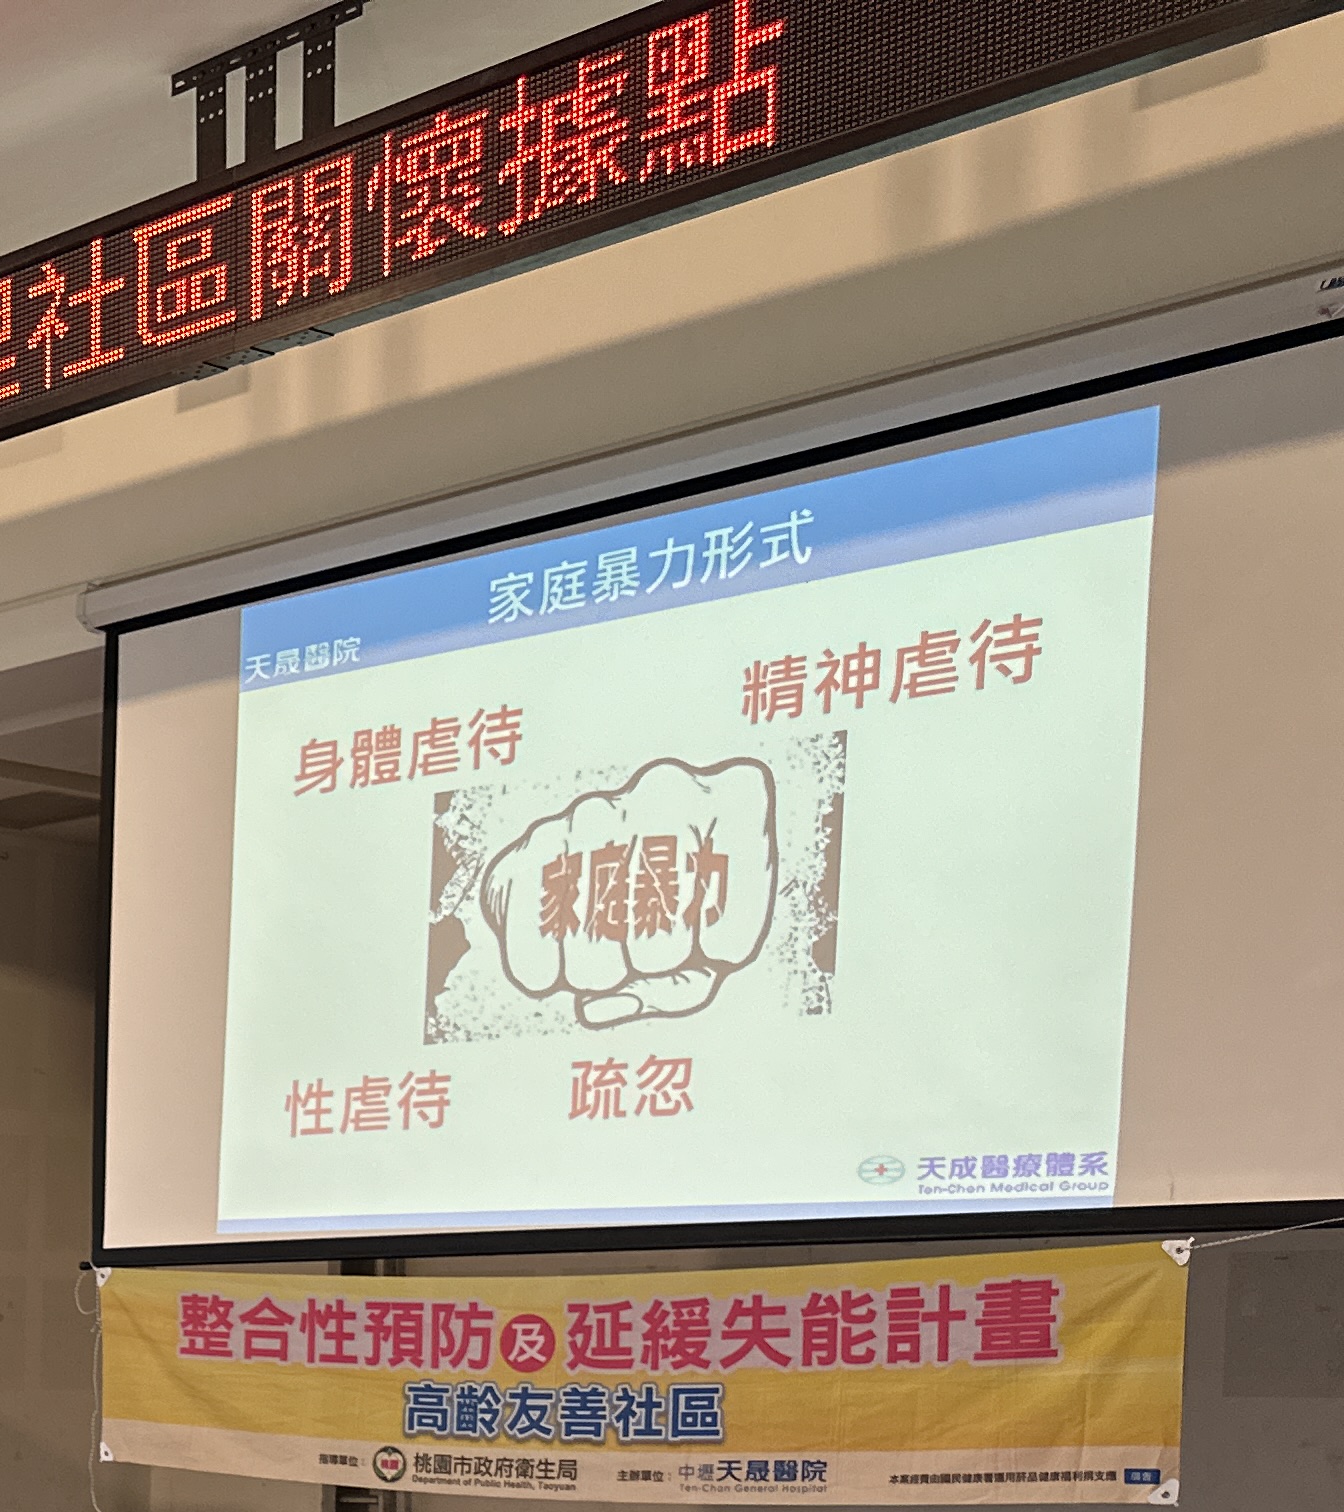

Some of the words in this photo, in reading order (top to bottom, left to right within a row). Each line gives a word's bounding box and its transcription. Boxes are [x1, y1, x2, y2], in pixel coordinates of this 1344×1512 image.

[488, 508, 815, 625] 家庭暴力形式
[244, 636, 361, 685] 天晟醫院
[740, 612, 1045, 725] 精神虐待
[293, 704, 525, 798] 身體虐待
[538, 833, 729, 943] 家庭暴力
[283, 1068, 453, 1139] 性虐待
[568, 1053, 696, 1124] 疏忽
[917, 1150, 1109, 1181] 天成醫療體系
[990, 1181, 1054, 1193] Medical
[1059, 1180, 1109, 1192] Group
[179, 1279, 1060, 1372] 整合性預防及延緩失能計畫
[406, 1381, 722, 1440] 高齡友善社區
[413, 1452, 578, 1481] 桃園市政府衛生局
[474, 1479, 501, 1488] Public
[734, 1484, 779, 1492] General
[782, 1484, 828, 1494] Hospital
